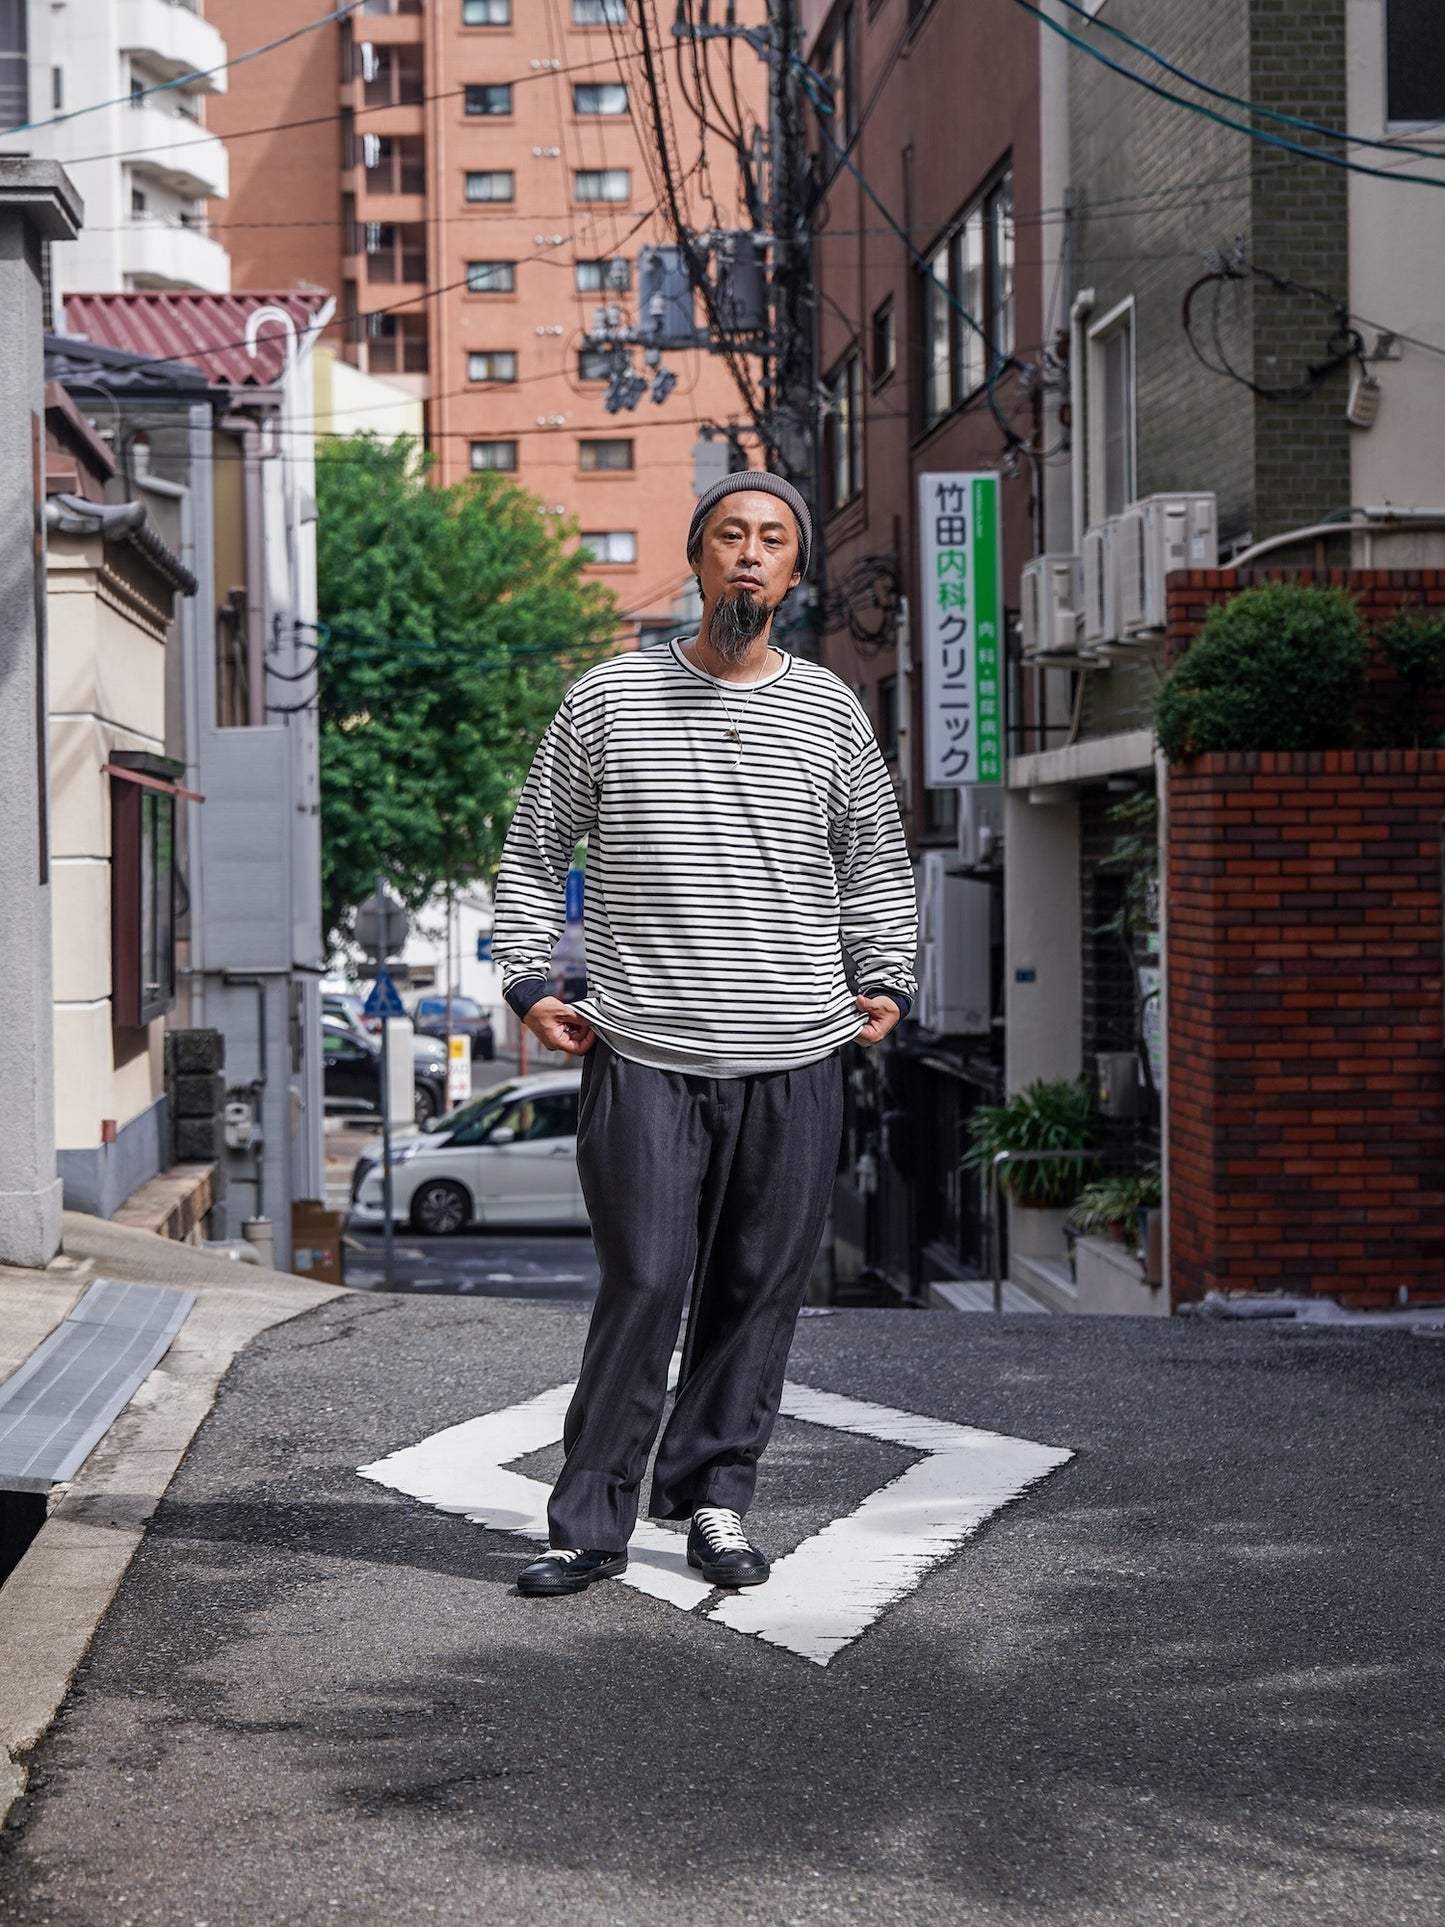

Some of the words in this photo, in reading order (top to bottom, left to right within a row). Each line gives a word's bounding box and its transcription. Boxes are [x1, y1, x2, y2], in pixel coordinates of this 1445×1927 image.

[935, 483, 969, 777] 竹田内科クリニック
